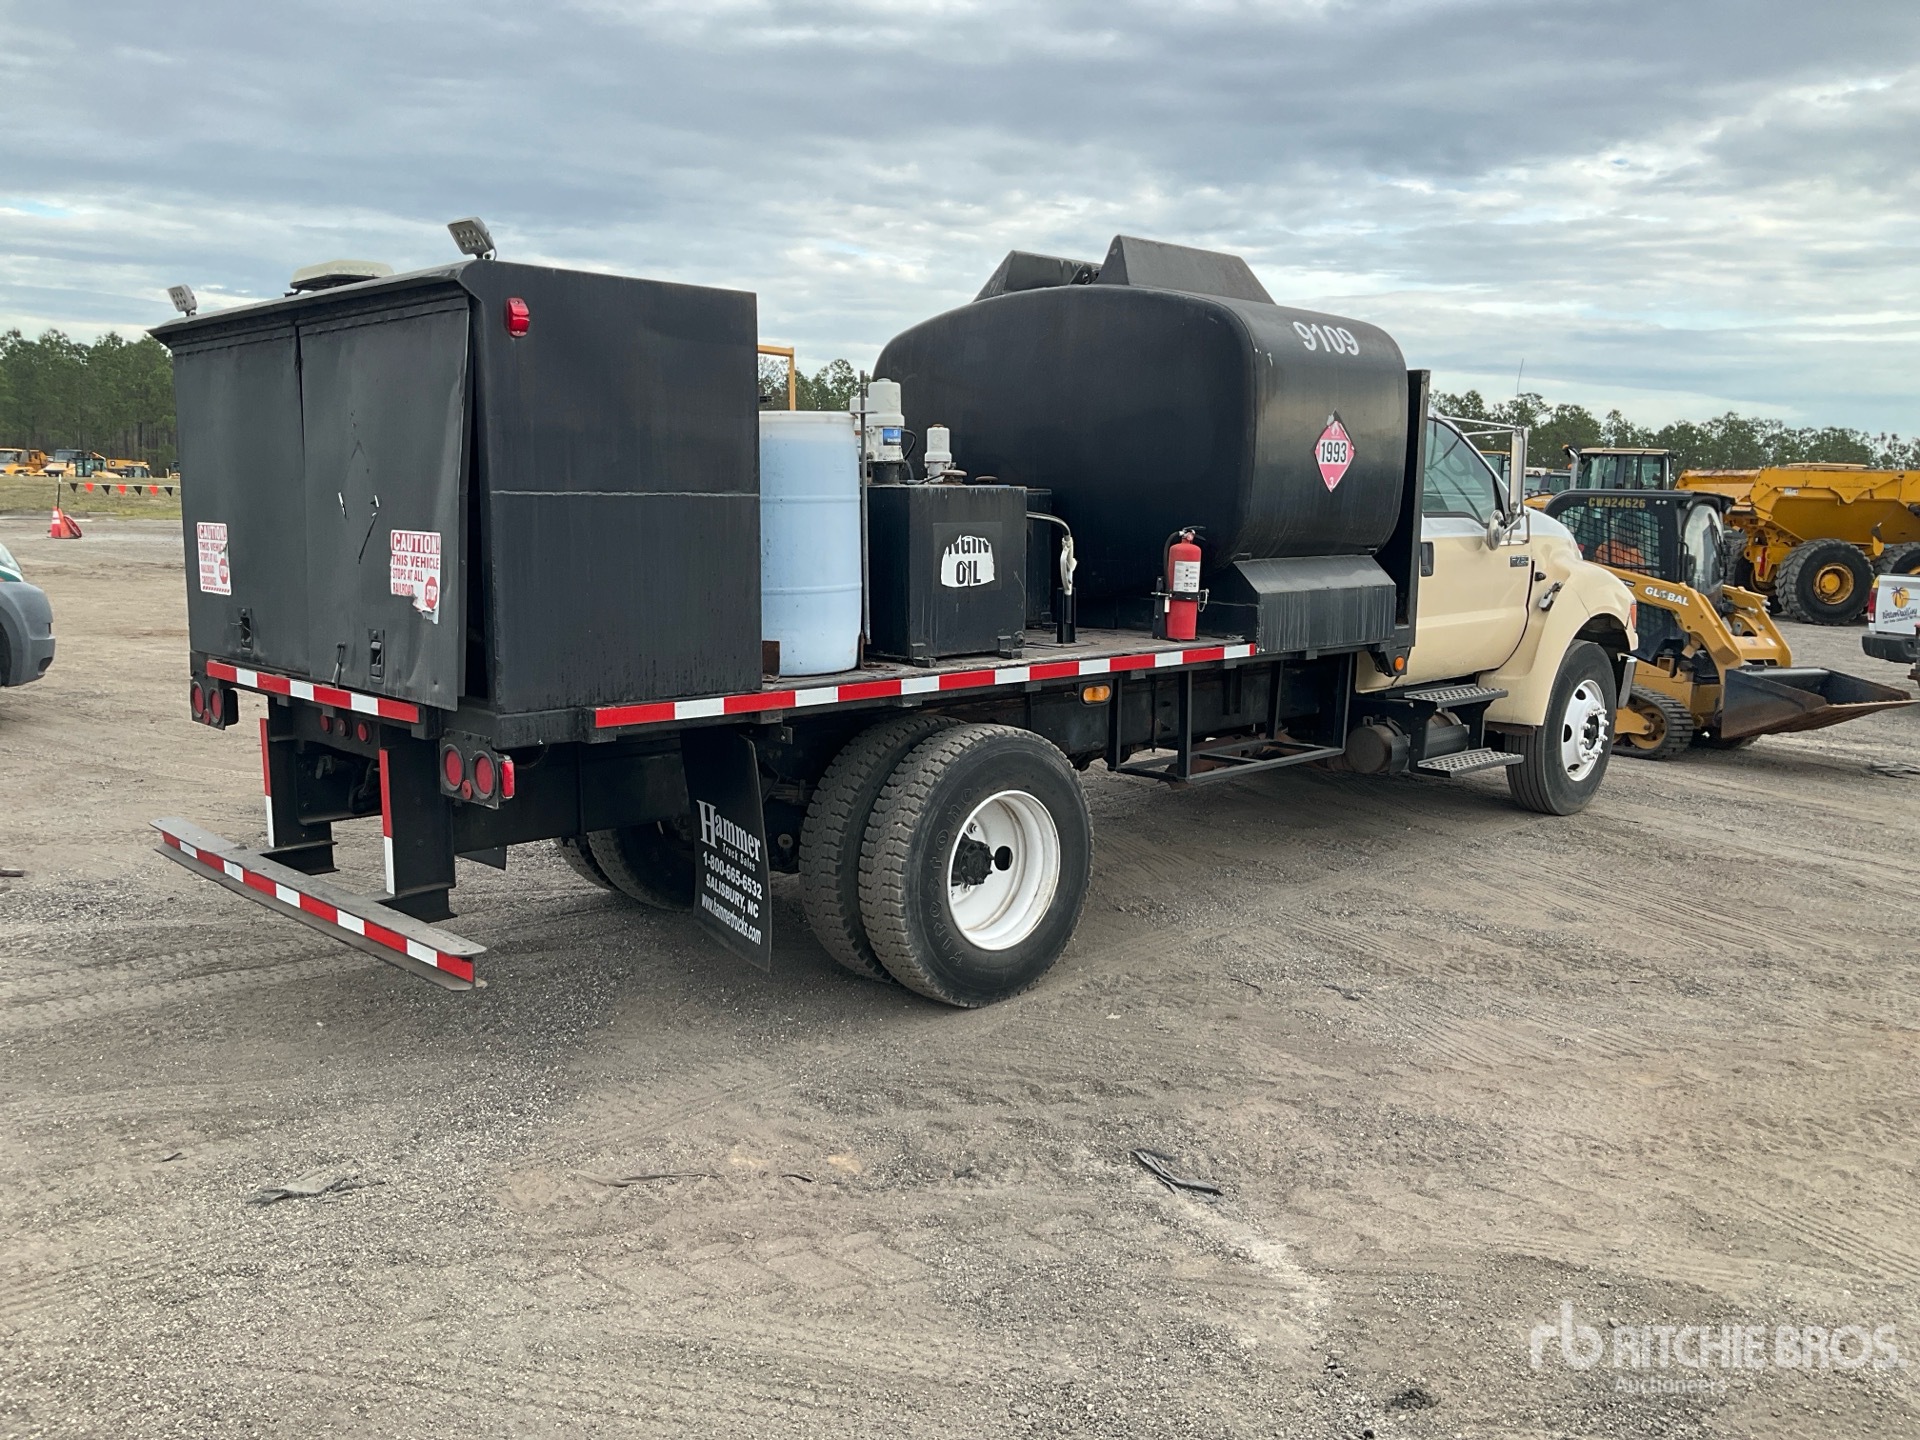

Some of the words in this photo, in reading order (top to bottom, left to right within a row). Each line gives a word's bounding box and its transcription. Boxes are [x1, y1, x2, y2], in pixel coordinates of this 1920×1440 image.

[1293, 321, 1359, 355] 9109
[1321, 441, 1347, 463] 1993
[1588, 497, 1646, 509] CW924626
[199, 525, 227, 541] CAUTION!
[393, 532, 440, 554] CAUTION!
[946, 536, 990, 555] NGIN
[392, 553, 408, 567] THIS
[410, 555, 439, 570] VEHICLE
[392, 568, 406, 580] STOPS
[414, 570, 424, 582] ALL
[956, 561, 981, 585] OIL
[1645, 586, 1689, 607] GLOBAL
[696, 799, 761, 863] Hammer
[723, 842, 738, 861] Truck
[740, 853, 755, 872] Sales
[703, 851, 762, 900] 1-800-665-6532
[706, 873, 745, 913] SALISBURY,
[747, 899, 759, 919] NC
